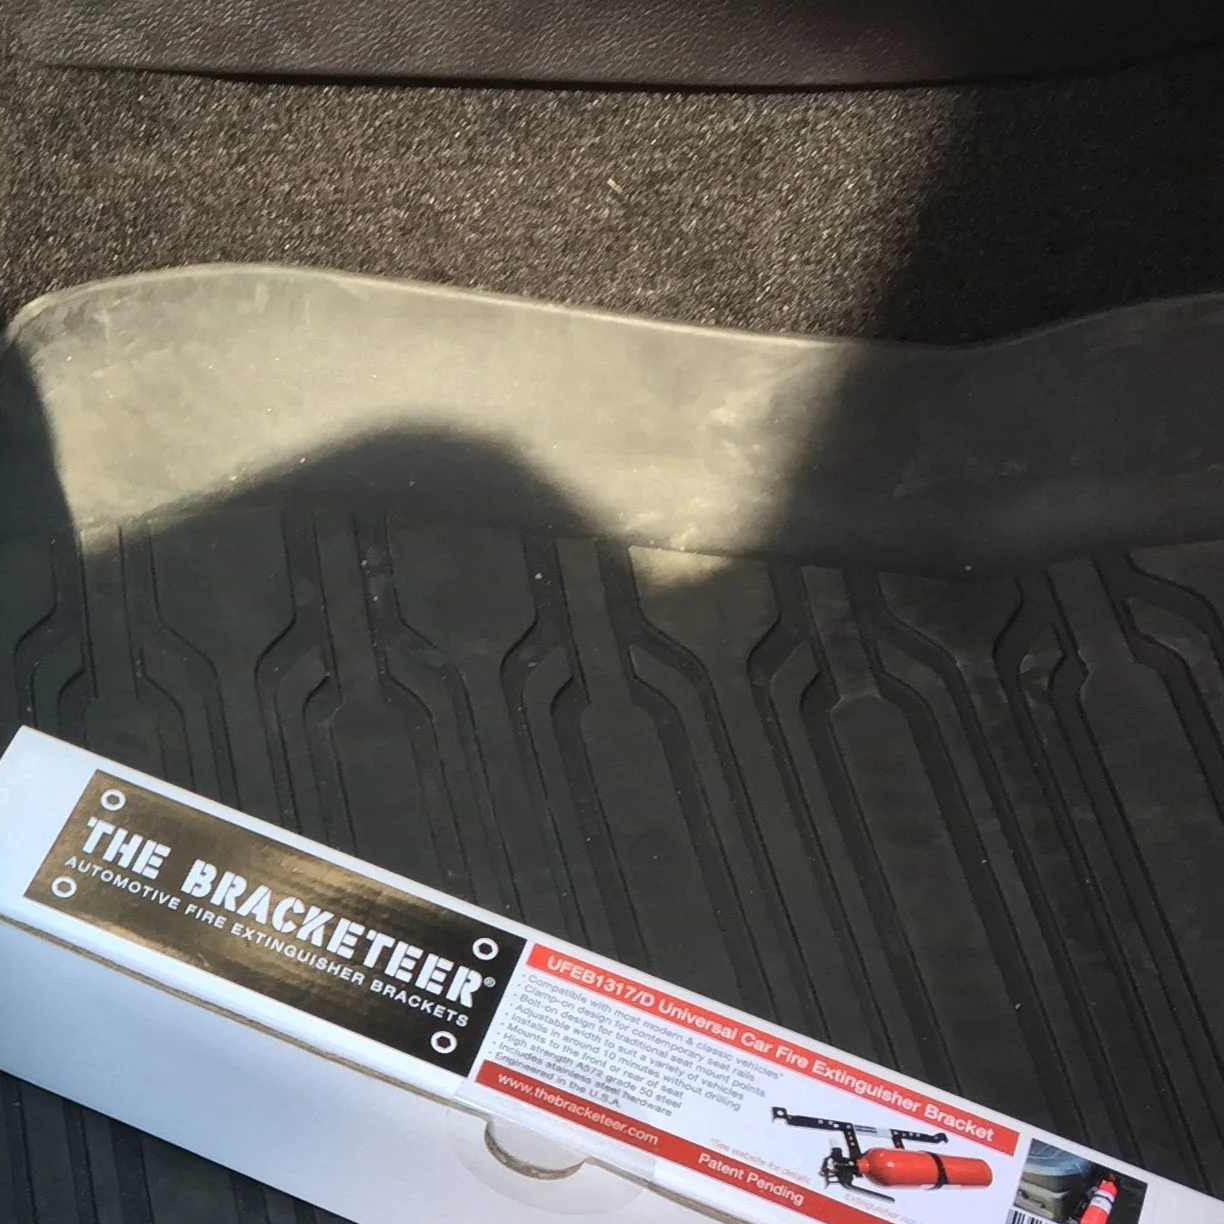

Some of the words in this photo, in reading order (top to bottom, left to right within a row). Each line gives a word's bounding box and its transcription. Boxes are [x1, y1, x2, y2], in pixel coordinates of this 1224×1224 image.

[73, 815, 172, 881] THE
[63, 854, 182, 911] AUTOMOTIVE
[183, 902, 228, 929] FIRE
[230, 920, 366, 985] EXTINGUISHER
[369, 976, 471, 1028] BRACKETS
[506, 1022, 547, 1044] Mounts
[548, 1038, 561, 1050] to
[561, 1044, 580, 1057] the
[580, 1051, 608, 1069] front
[608, 1064, 620, 1074] or
[622, 1069, 644, 1083] rear
[646, 1077, 659, 1089] of
[659, 1083, 684, 1099] seat
[510, 1012, 550, 1034] Installs
[550, 1028, 561, 1039] in
[562, 1033, 600, 1054] around
[602, 1049, 616, 1061] 10
[617, 1055, 661, 1078] minutes
[661, 1072, 703, 1095] without
[703, 1089, 742, 1112] drilling
[513, 1002, 571, 1033] Adjustable
[572, 1025, 602, 1044] width
[602, 1038, 615, 1049] to
[616, 1043, 638, 1058] suit
[639, 1054, 647, 1062] a
[647, 1056, 685, 1078] variety
[685, 1070, 699, 1082] of
[700, 1076, 745, 1101] vehicles
[518, 992, 559, 1015] Bolt-on
[559, 1009, 595, 1031] design
[597, 1024, 614, 1037] for
[614, 1031, 669, 1059] traditional
[669, 1052, 694, 1069] seat
[694, 1062, 730, 1084] mount
[731, 1077, 766, 1099] points
[522, 983, 576, 1012] Clamp-on
[575, 1004, 613, 1027] design
[613, 1018, 630, 1032] for
[630, 1025, 705, 1063] contemporary
[706, 1055, 731, 1072] seat
[731, 1065, 756, 1082] rails
[526, 973, 588, 1005] Compatible
[588, 997, 613, 1013] with
[613, 1007, 641, 1024] most
[641, 1018, 684, 1042] modern
[684, 1035, 695, 1046] &
[695, 1039, 734, 1061] classic
[545, 954, 656, 1008] UFEB1317/D
[656, 998, 738, 1041] Universal
[739, 1030, 774, 1055] Car
[774, 1044, 811, 1070] Fire
[810, 1058, 922, 1116] Extinguisher
[923, 1102, 995, 1143] Bracket
[493, 1051, 554, 1082] Engineered
[555, 1075, 568, 1086] in
[568, 1081, 587, 1094] the
[498, 1041, 544, 1066] Includes
[545, 1060, 593, 1085] stainless
[593, 1079, 621, 1096] steel
[622, 1091, 673, 1117] hardware
[501, 1031, 528, 1049] High
[528, 1042, 574, 1067] strength
[604, 1072, 637, 1093] grade
[638, 1086, 653, 1098] 50
[654, 1092, 682, 1110] steel
[496, 1071, 659, 1146] www.thebracketeer.com
[697, 1151, 745, 1181] Patent
[745, 1171, 805, 1207] Pending
